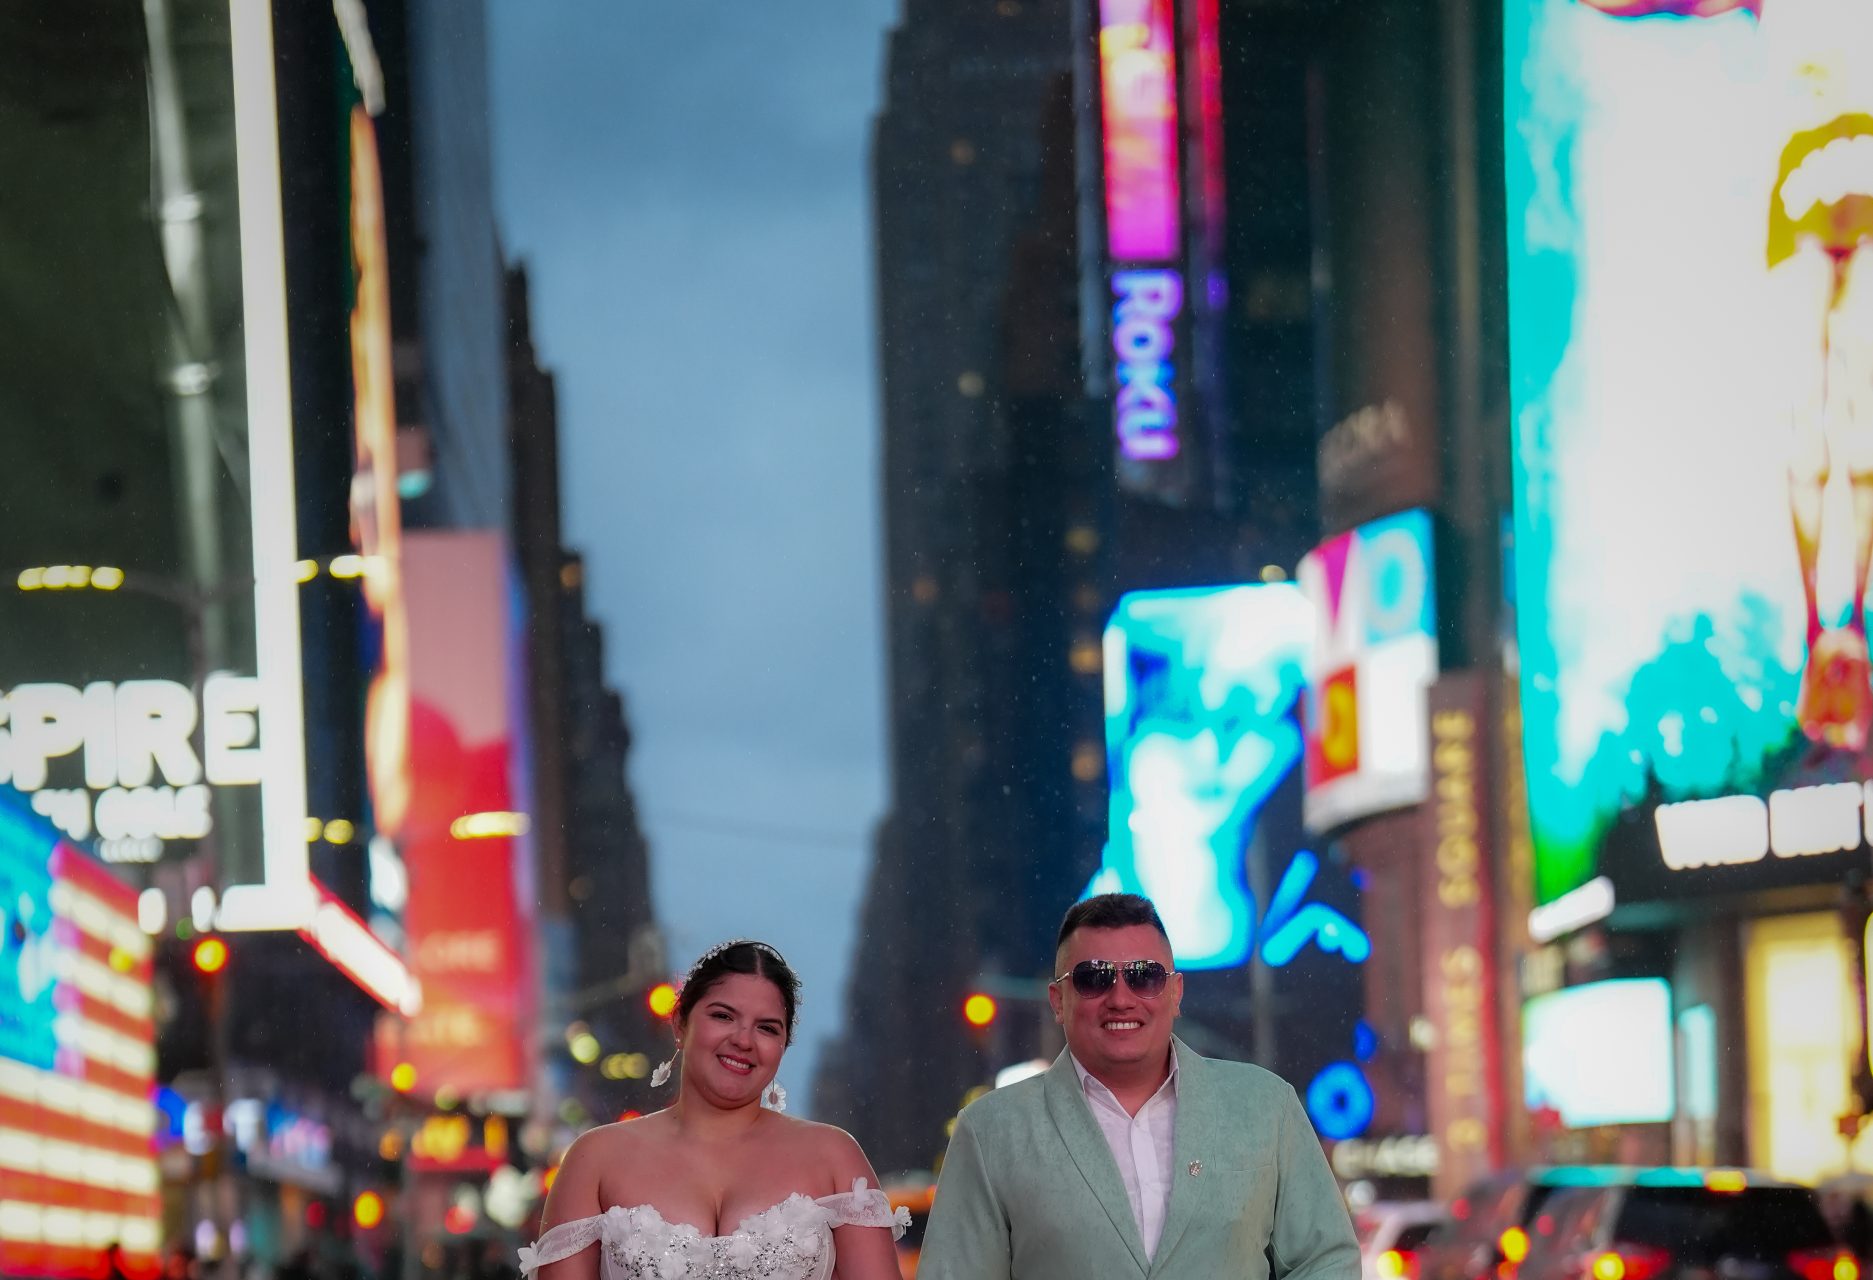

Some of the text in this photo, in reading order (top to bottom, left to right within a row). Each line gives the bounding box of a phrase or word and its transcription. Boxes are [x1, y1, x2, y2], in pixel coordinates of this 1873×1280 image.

[1111, 268, 1184, 460] ROKU
[0, 678, 264, 790] PIRE
[1432, 709, 1481, 909] SQUARE
